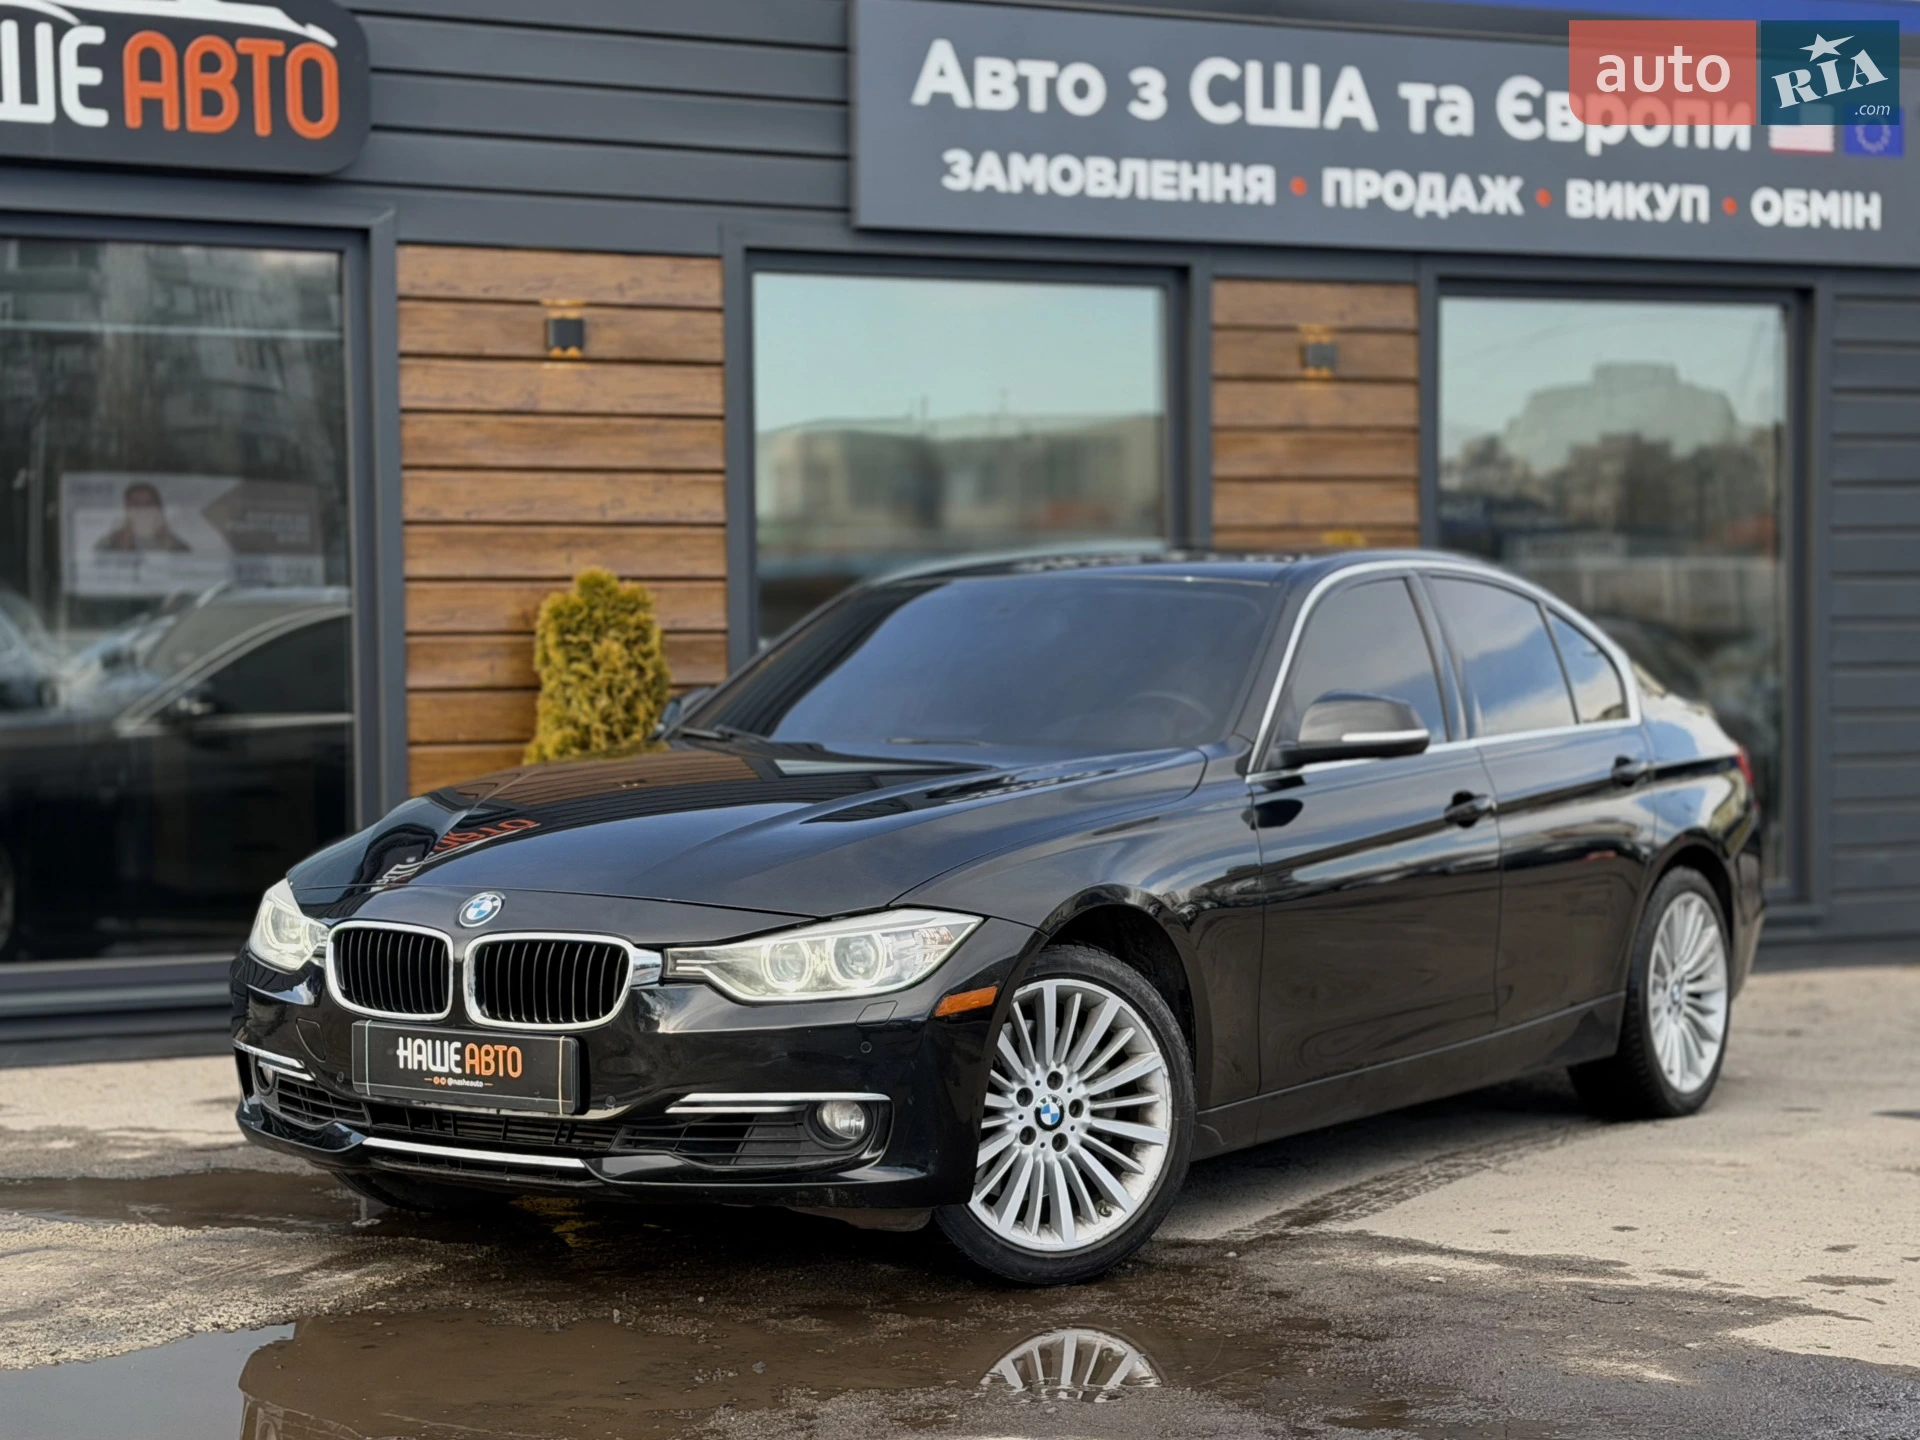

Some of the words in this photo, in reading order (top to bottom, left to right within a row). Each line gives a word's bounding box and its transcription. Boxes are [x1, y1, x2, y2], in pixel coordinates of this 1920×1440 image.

[123, 30, 340, 140] АВТО
[910, 38, 1107, 117] Авто
[1127, 66, 1168, 121] з
[1189, 57, 1379, 132] США
[1397, 82, 1475, 137] та
[1495, 75, 1752, 156] Європи
[941, 148, 1276, 206] ЗАМОВЛЕННЯ
[1322, 167, 1524, 219] ПРОДАЖ
[1565, 179, 1710, 224] ВИКУП
[1750, 187, 1882, 230] ОБМІН
[396, 1036, 463, 1074] НАШЕ
[464, 1042, 523, 1079] АВТО
